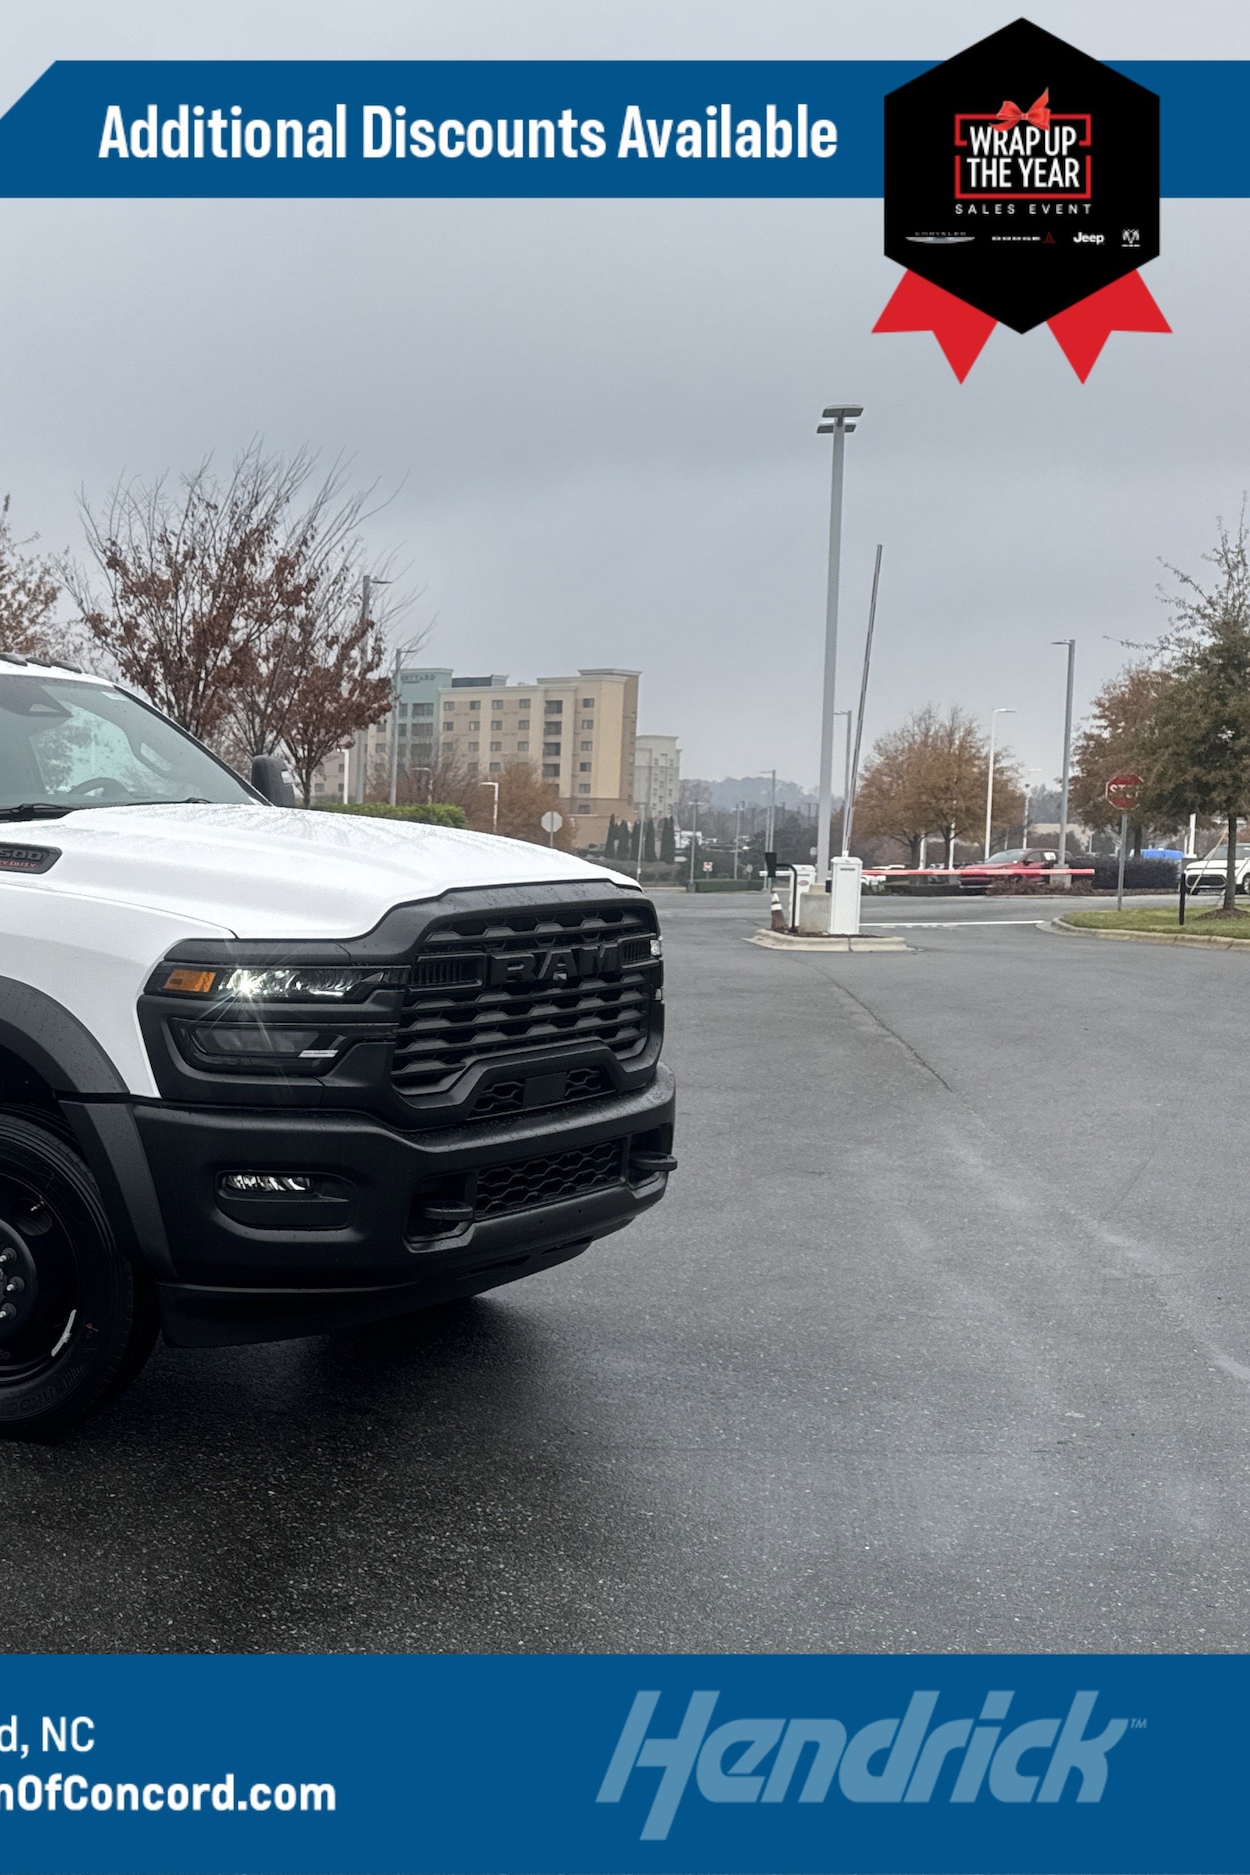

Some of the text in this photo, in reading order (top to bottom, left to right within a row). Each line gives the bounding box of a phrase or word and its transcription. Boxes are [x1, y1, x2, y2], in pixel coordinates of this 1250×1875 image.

[1110, 784, 1139, 799] ST
[9, 860, 37, 868] DUTY
[491, 943, 619, 986] RAM
